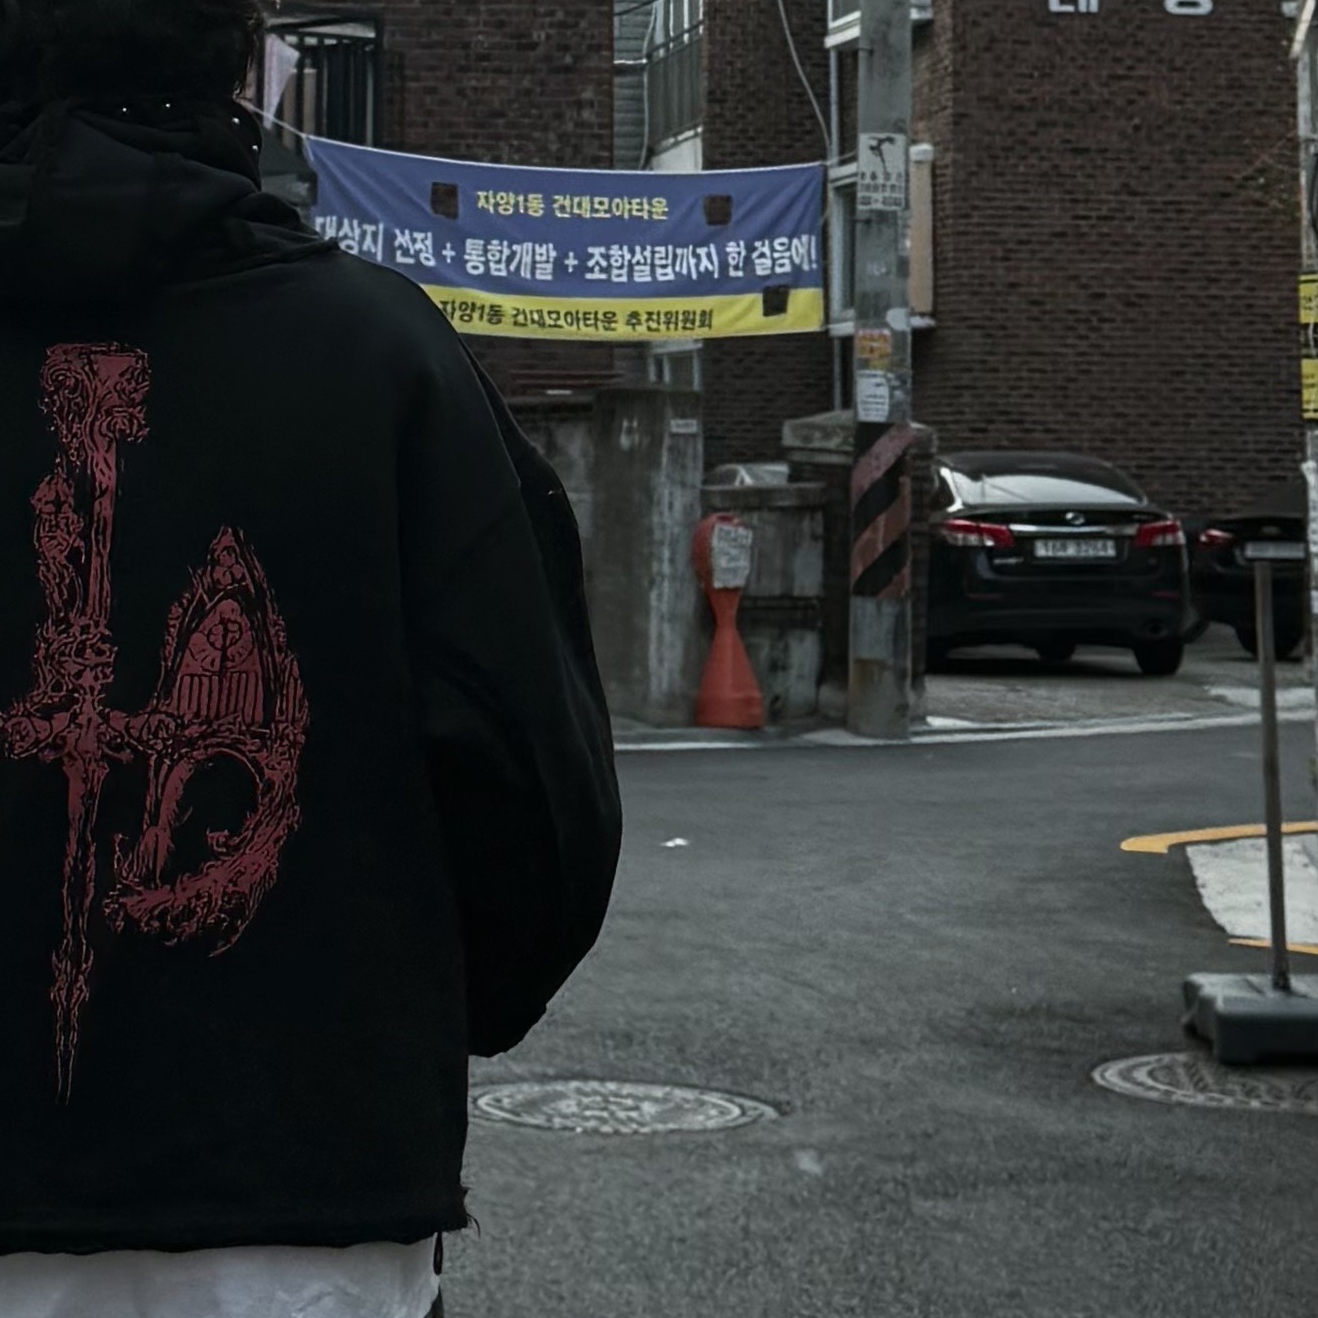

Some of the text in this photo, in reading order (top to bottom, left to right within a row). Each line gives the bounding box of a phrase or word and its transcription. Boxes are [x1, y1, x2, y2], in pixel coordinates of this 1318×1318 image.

[477, 190, 669, 220] 자양1동 건대모아타운
[314, 215, 383, 262] 대상지
[394, 228, 436, 267] 선정
[464, 237, 557, 280] 통합개발
[585, 242, 720, 283] 조합설립까지
[725, 239, 746, 278] 한
[751, 233, 818, 277] 걸음에!
[439, 299, 714, 333] 자양1동 건대모아타운 추진위원회
